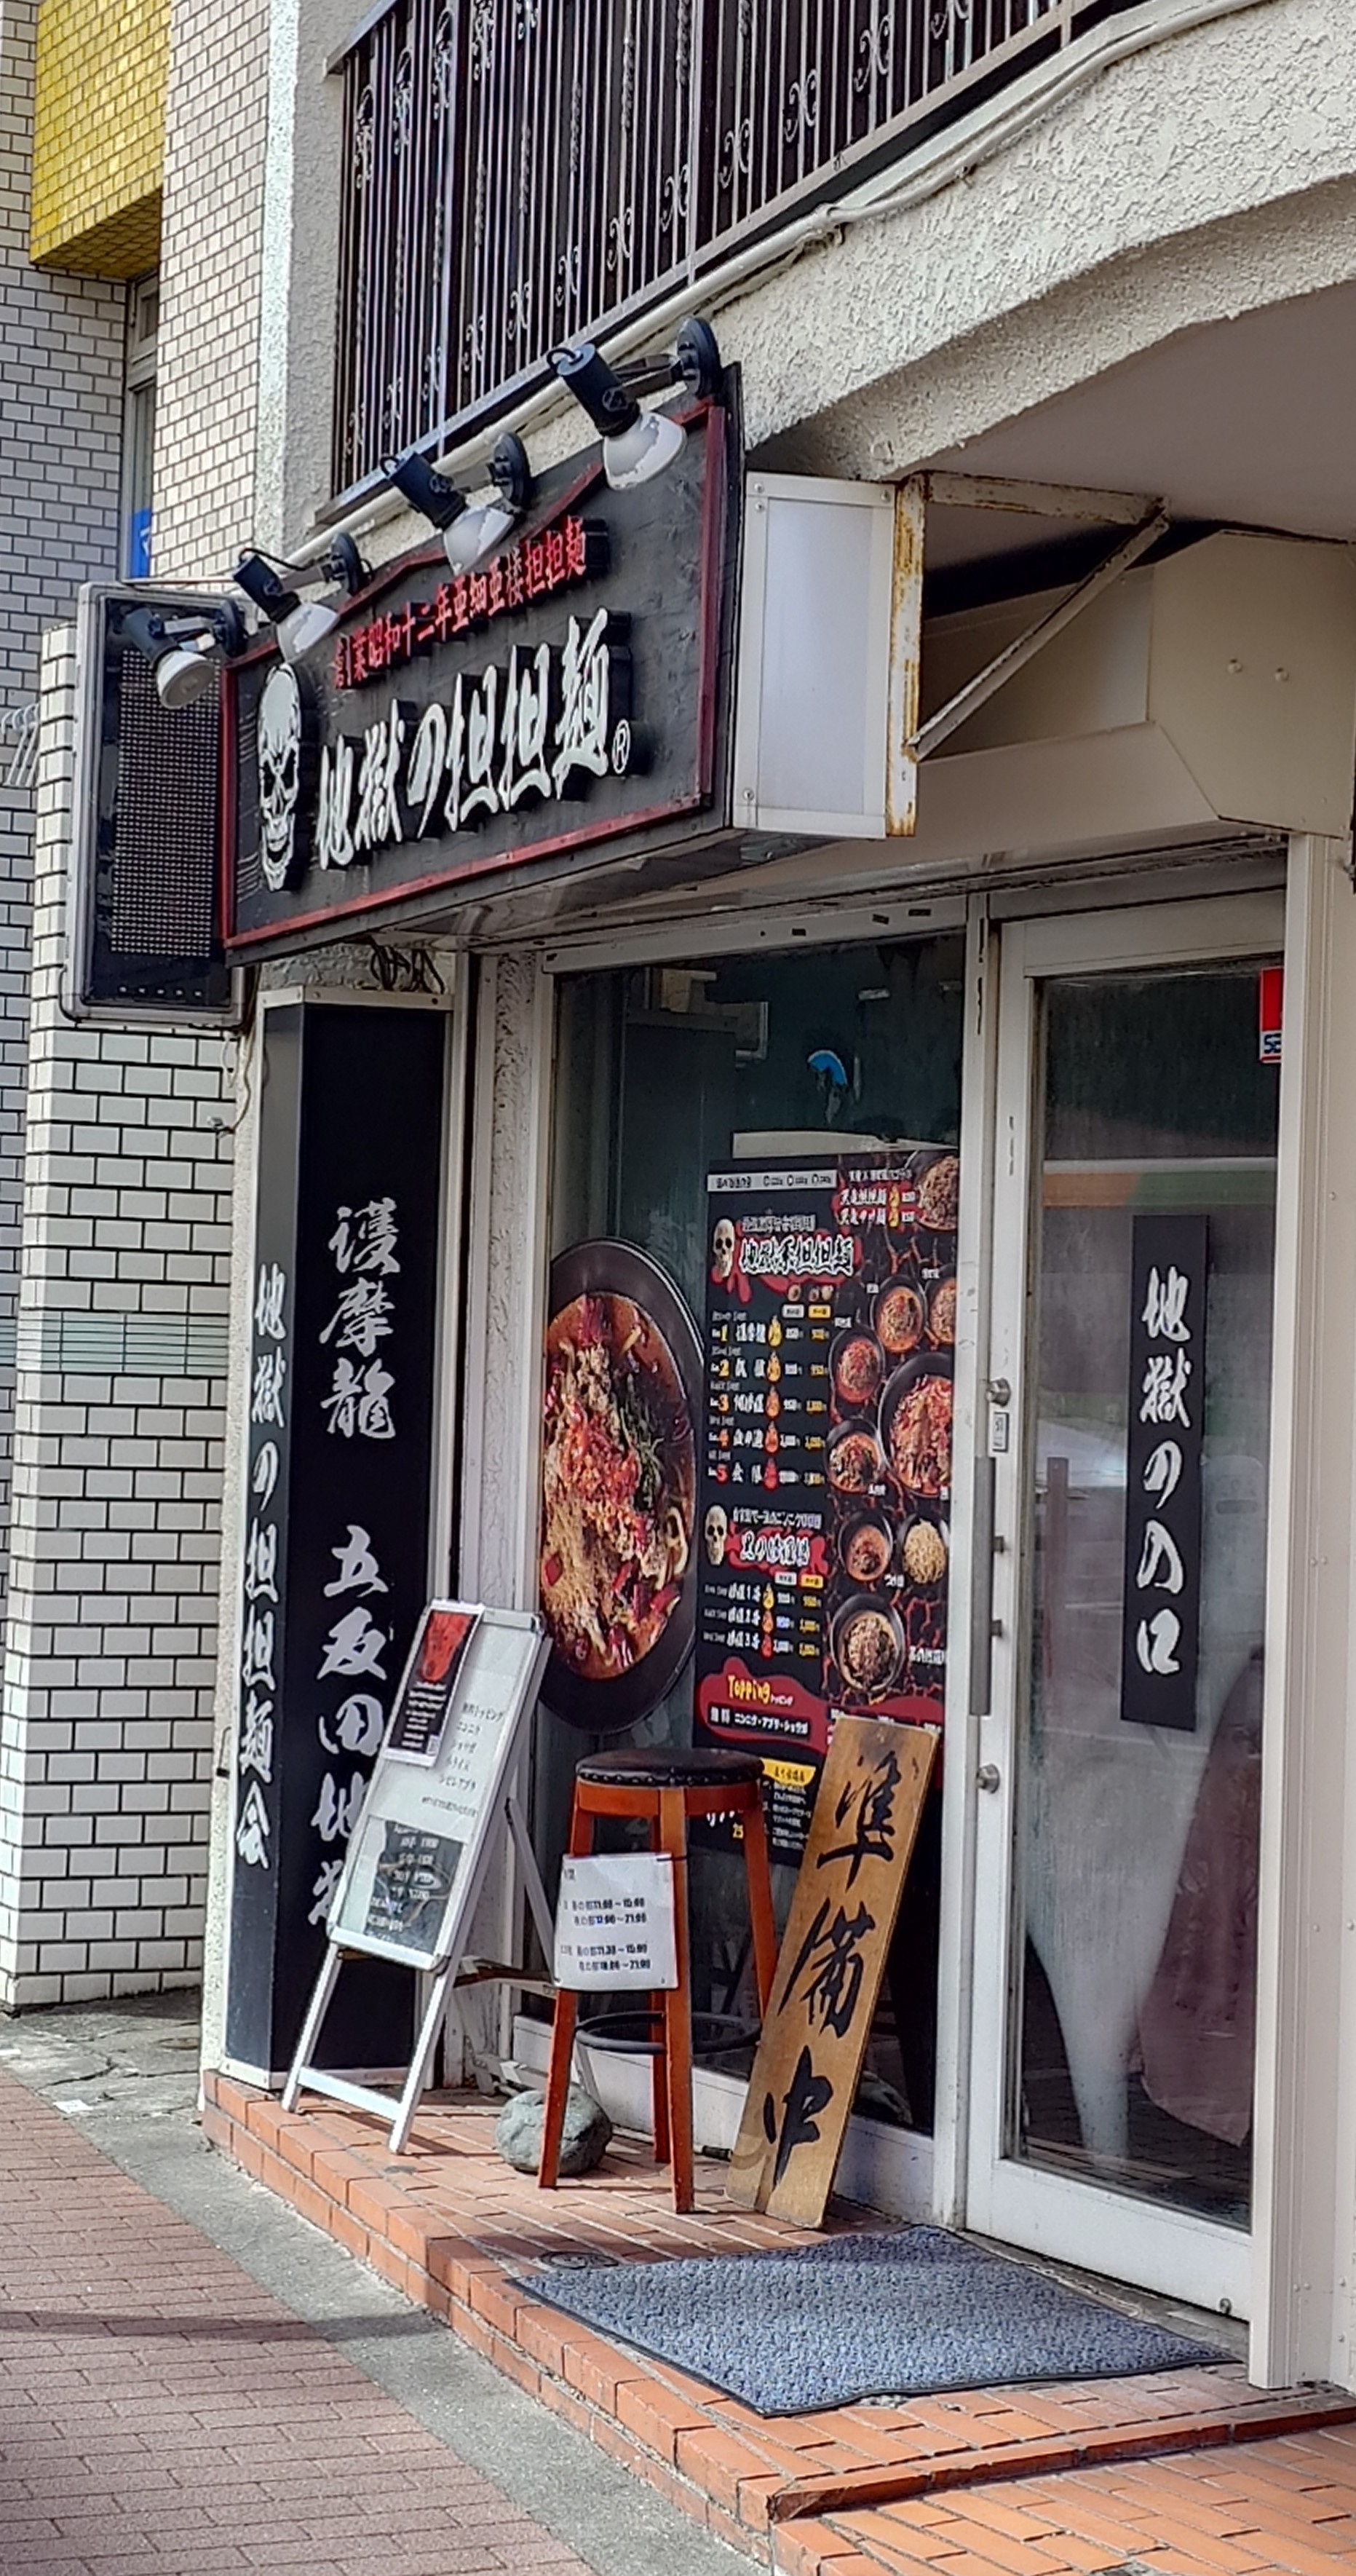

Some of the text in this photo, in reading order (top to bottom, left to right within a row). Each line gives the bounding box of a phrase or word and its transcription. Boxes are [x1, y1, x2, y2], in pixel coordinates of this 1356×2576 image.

[319, 1197, 401, 1439] 護摩龍
[764, 1750, 903, 2186] 準備中
